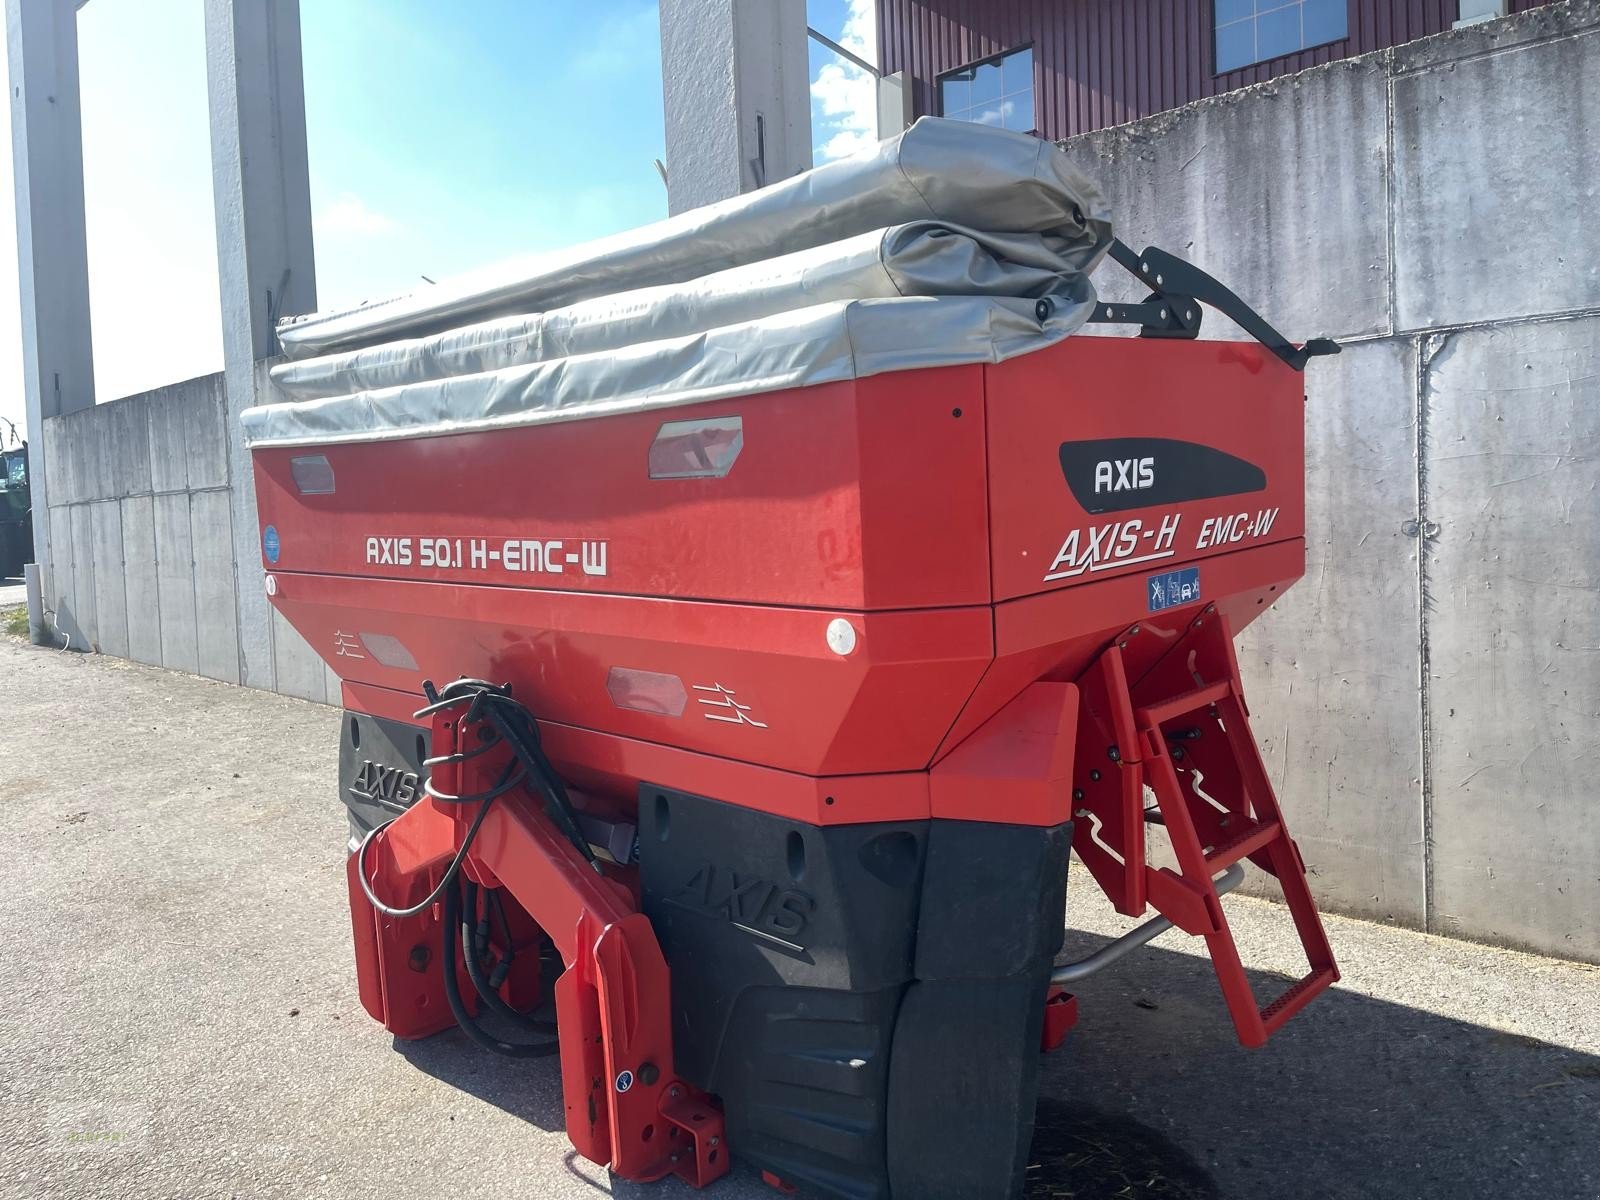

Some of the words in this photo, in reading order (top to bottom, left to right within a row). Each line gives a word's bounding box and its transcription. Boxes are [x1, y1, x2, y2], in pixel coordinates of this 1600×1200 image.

[1094, 457, 1154, 493] AXIS
[366, 537, 413, 566] AXIS
[419, 538, 463, 569] 50.1
[1048, 513, 1182, 571] AXIS-H
[1195, 507, 1280, 550] EMC+W
[352, 759, 420, 804] AXIS
[665, 863, 816, 936] AXIS
